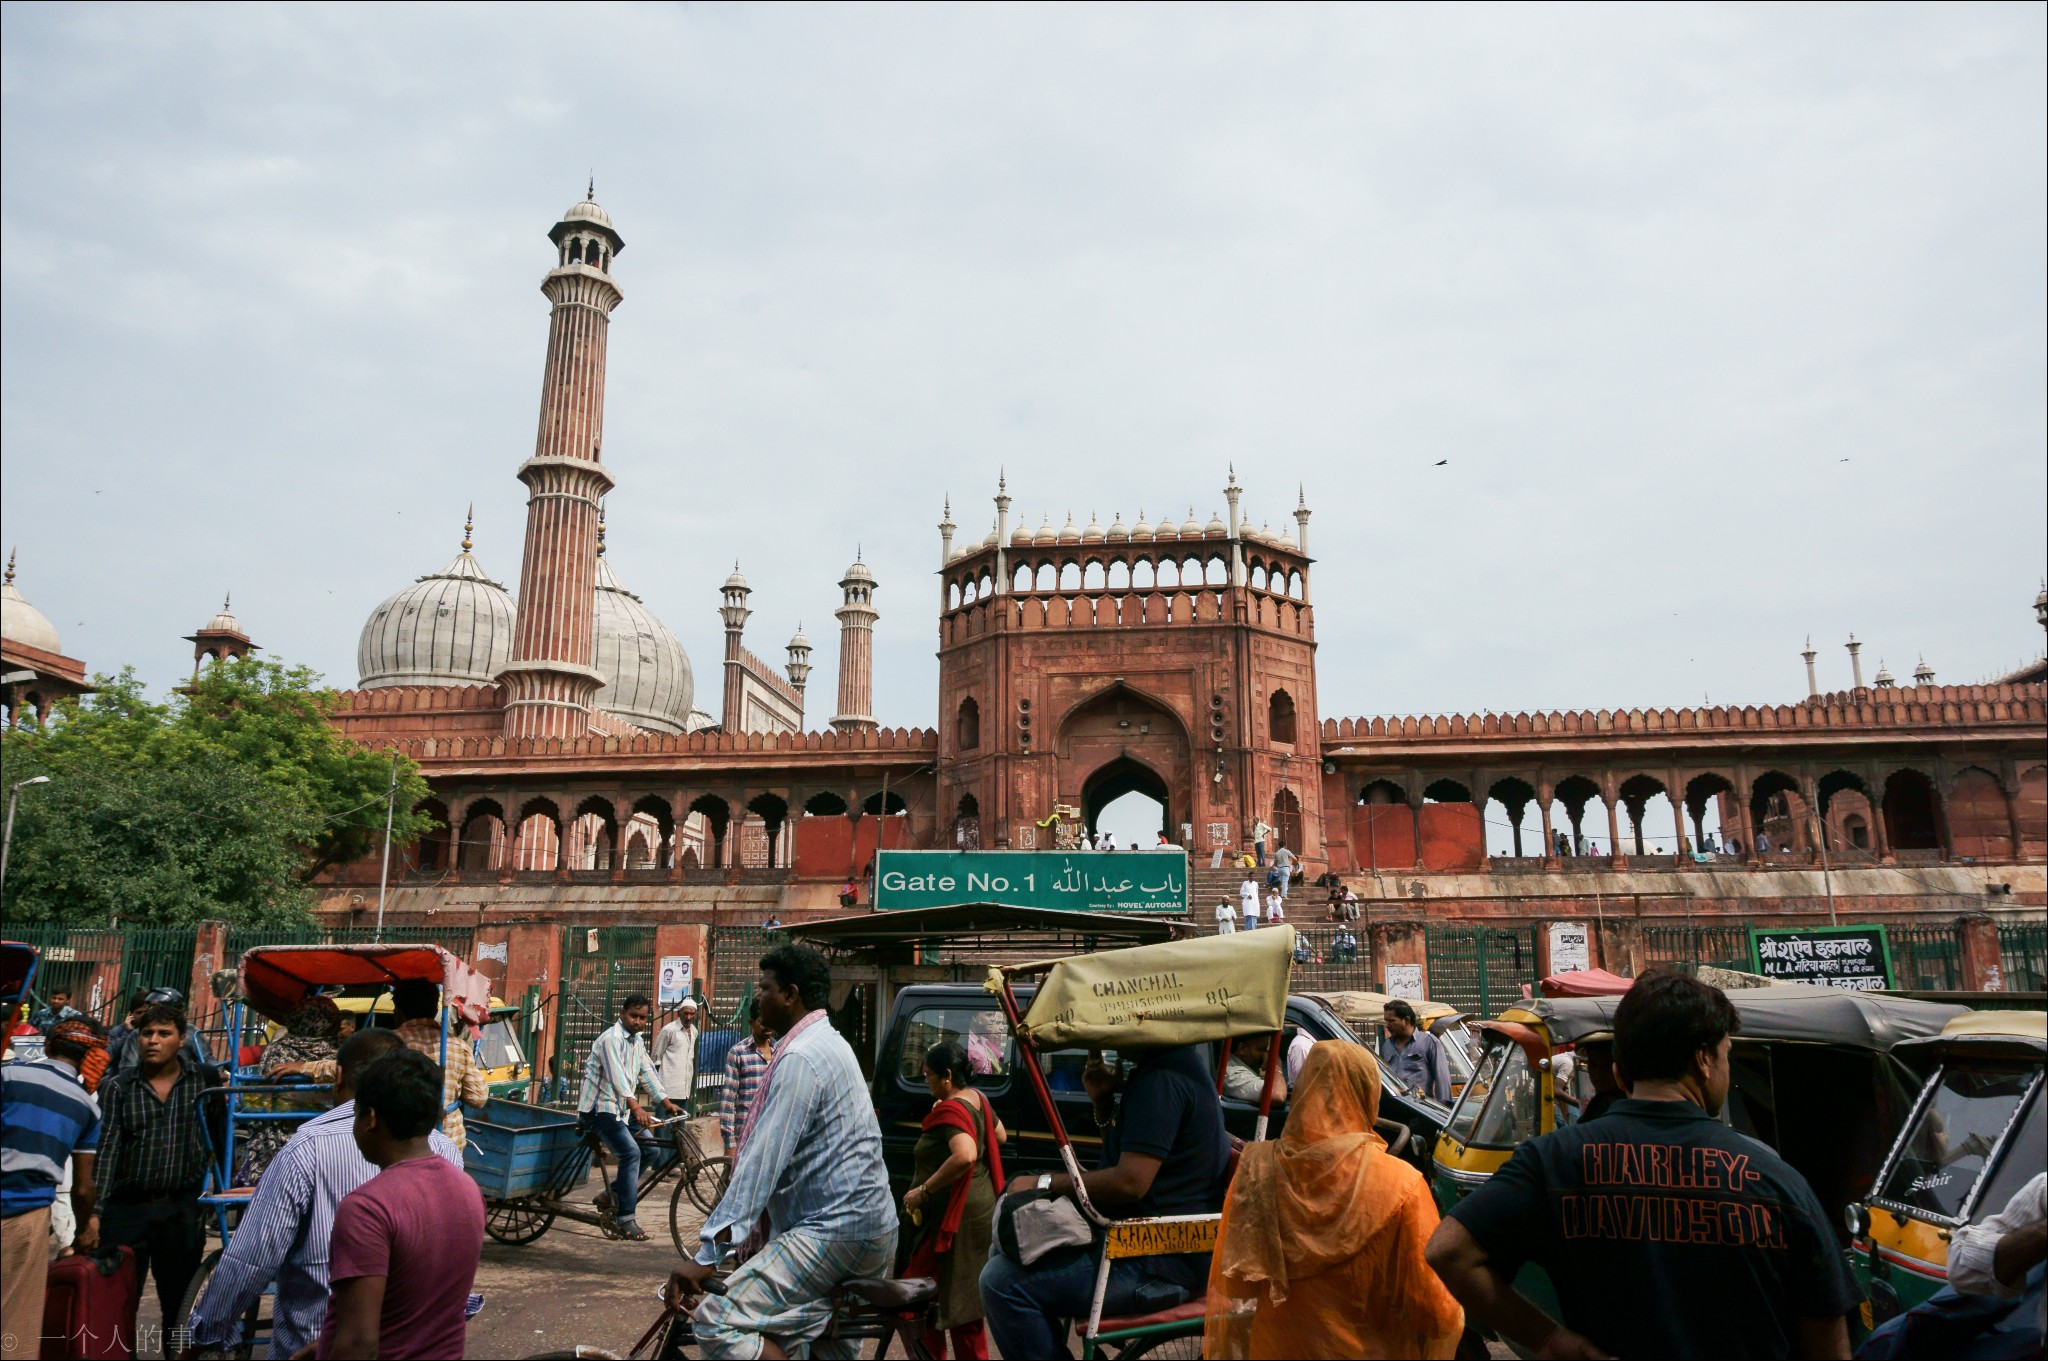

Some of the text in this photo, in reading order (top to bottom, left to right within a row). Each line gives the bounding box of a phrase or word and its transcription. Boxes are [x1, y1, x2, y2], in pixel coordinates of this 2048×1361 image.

[882, 871, 1035, 892] Gate No.1
[1093, 876, 1134, 899] عبد
[1140, 873, 1183, 899] باب
[1760, 937, 1777, 959] श्री
[1764, 962, 1795, 974] M.L.A.
[1093, 973, 1183, 997] CHANCHAL
[1206, 987, 1229, 1007] 80
[1583, 1143, 1761, 1191] HARLEY-
[1117, 1224, 1213, 1243] CHANCHAL
